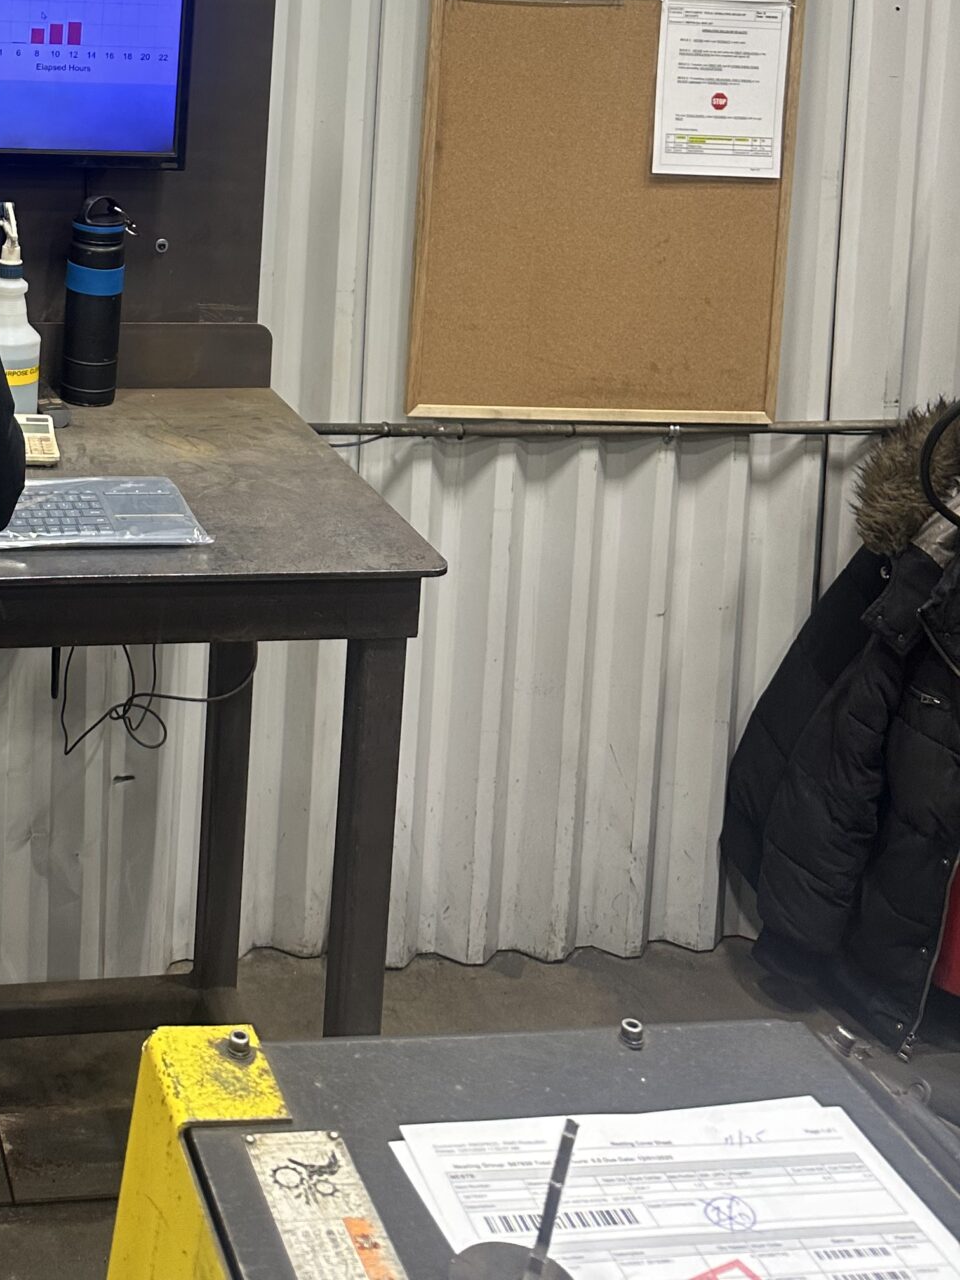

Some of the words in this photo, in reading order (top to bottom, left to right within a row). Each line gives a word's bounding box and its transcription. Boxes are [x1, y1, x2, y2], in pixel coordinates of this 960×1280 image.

[51, 50, 60, 58] 10
[87, 51, 96, 59] 14
[105, 52, 114, 60] 16
[140, 53, 150, 61] 20
[158, 54, 168, 62] 22
[36, 63, 66, 72] Elapsed
[68, 64, 91, 72] Hours
[712, 97, 726, 105] STOP
